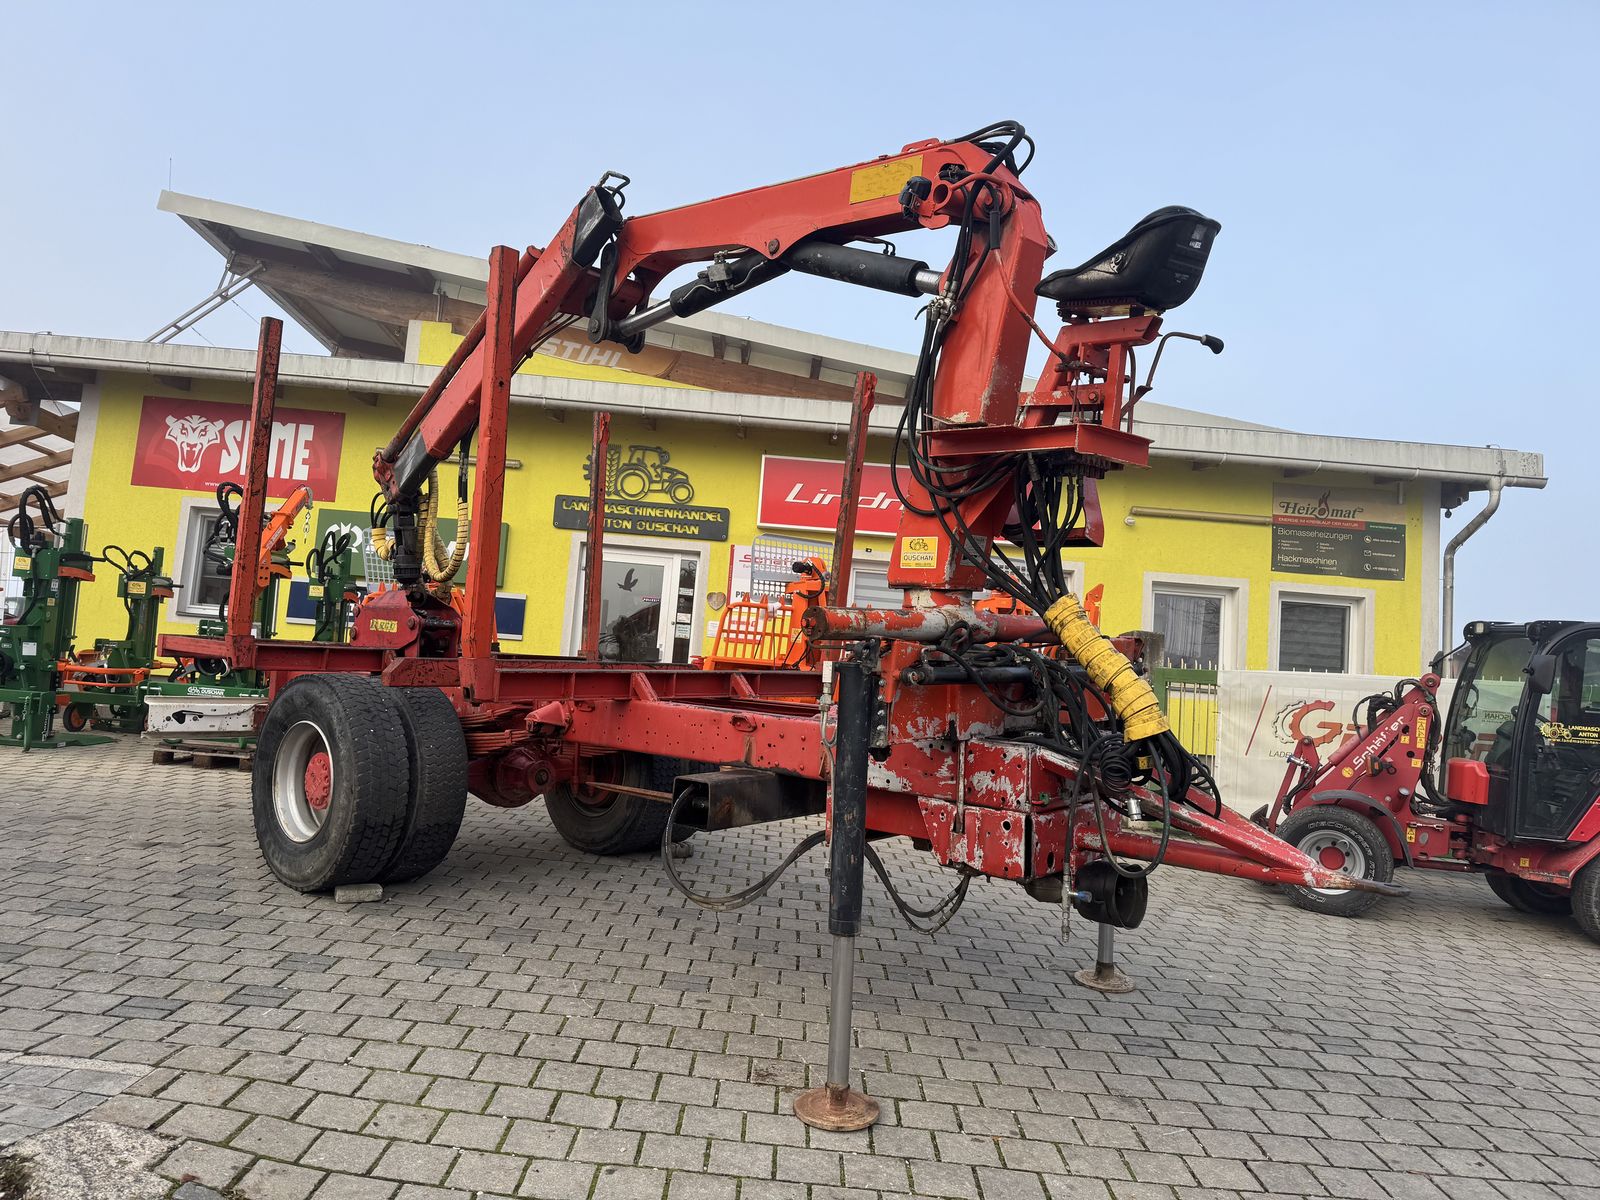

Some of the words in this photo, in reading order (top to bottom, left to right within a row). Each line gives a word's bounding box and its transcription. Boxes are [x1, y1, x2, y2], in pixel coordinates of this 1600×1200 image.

[603, 518, 632, 530] TON
[636, 522, 699, 535] OUSCHAN
[1277, 527, 1353, 541] Biomasseheizungen
[1277, 553, 1338, 566] Hackmaschinen
